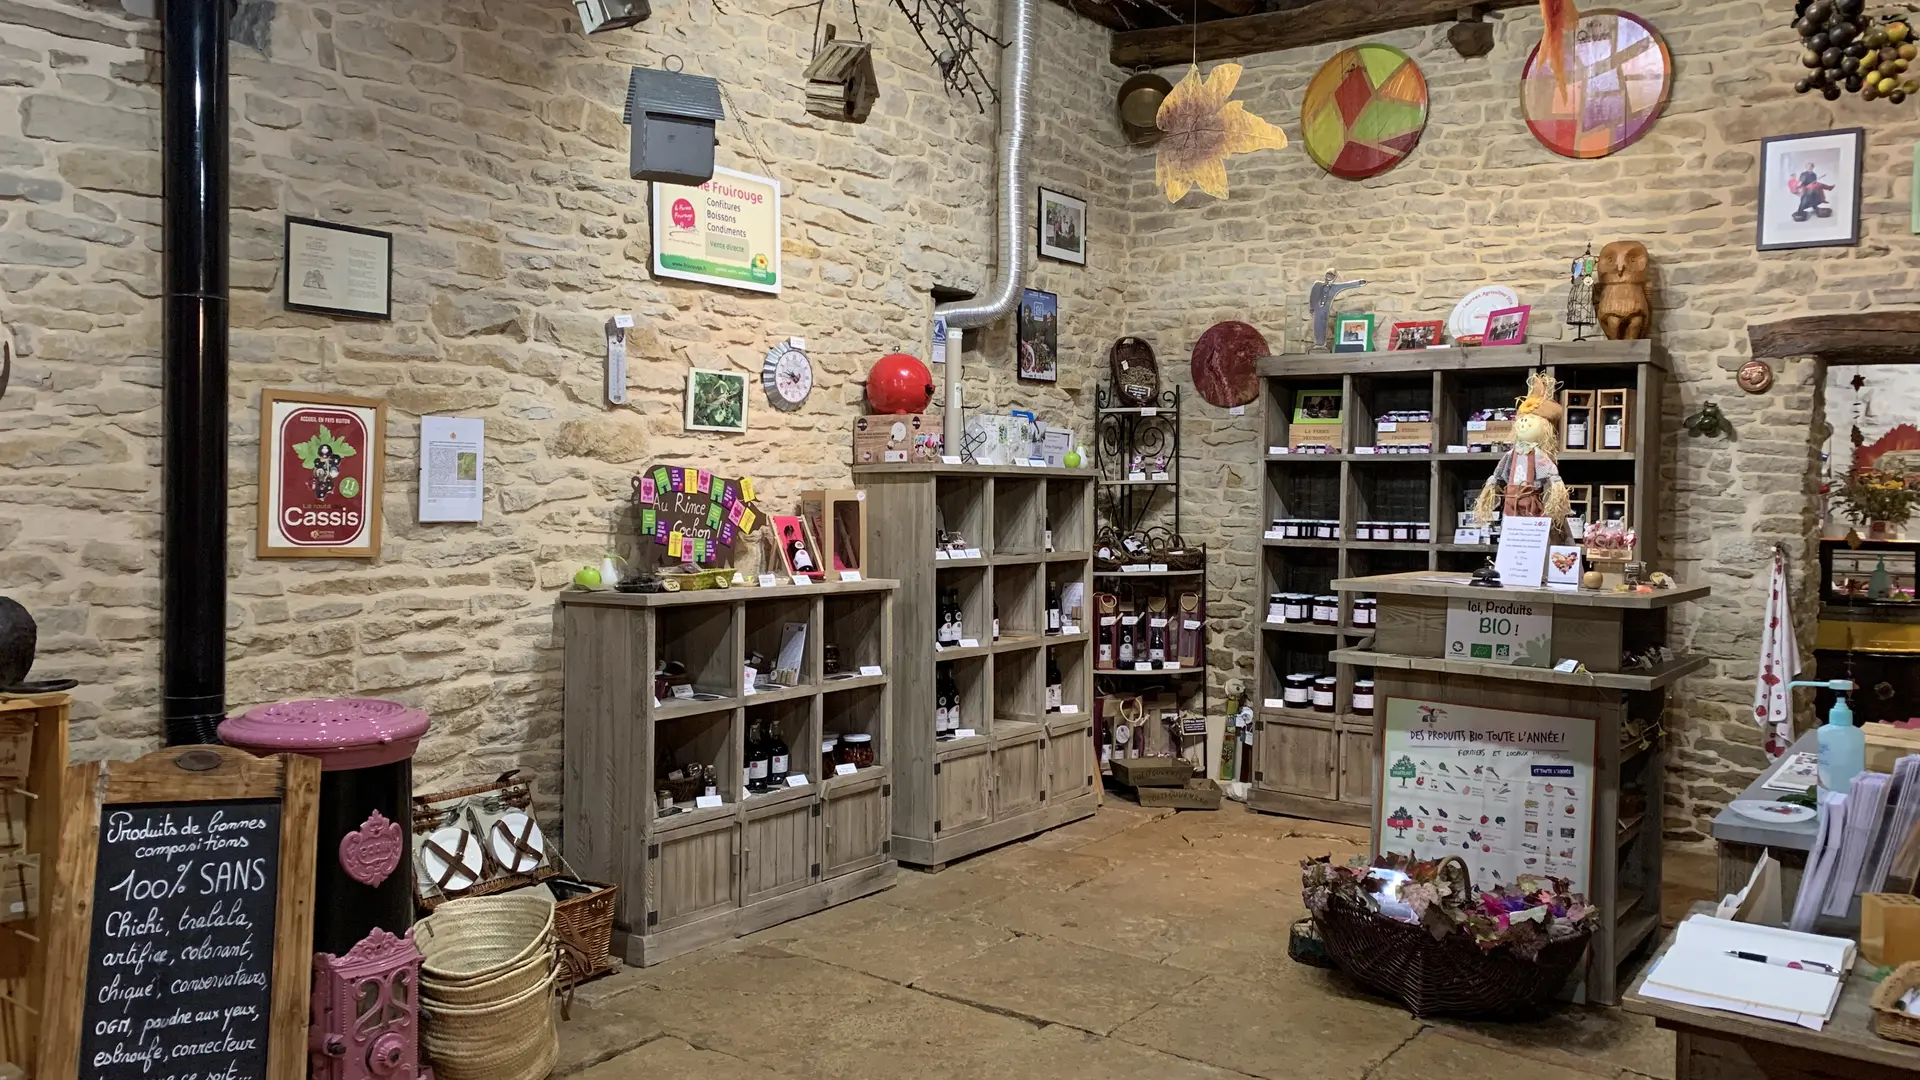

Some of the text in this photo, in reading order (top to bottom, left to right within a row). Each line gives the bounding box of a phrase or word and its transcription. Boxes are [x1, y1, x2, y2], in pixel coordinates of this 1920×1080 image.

[713, 182, 763, 205] Fruirouge
[706, 197, 741, 213] Confitures
[706, 209, 736, 224] Boissons
[706, 222, 747, 238] Condiments
[709, 240, 725, 250] Vente
[726, 243, 745, 253] directe
[652, 492, 706, 515] Au Rince
[284, 506, 359, 526] Cassis
[672, 517, 711, 539] Cochon
[1467, 600, 1533, 616] Ici, Produits
[1479, 617, 1511, 636] BIO
[1410, 730, 1425, 741] DES
[1427, 730, 1467, 743] PRODUITS
[1469, 731, 1484, 743] BIO
[1486, 731, 1516, 744] TOUTE
[1492, 749, 1502, 757] ET
[107, 810, 267, 843] Produits de bonnes
[135, 836, 250, 863] compositions
[109, 858, 266, 901] 100% SANS
[105, 898, 254, 937] Chichi, tralala,
[102, 932, 254, 976] artifice, colorant,
[98, 962, 269, 1014] chiqué, conservateurs,
[95, 1004, 260, 1046] OGM, poudre aux yeux,
[93, 1028, 257, 1074] esbroufe, correcteur
